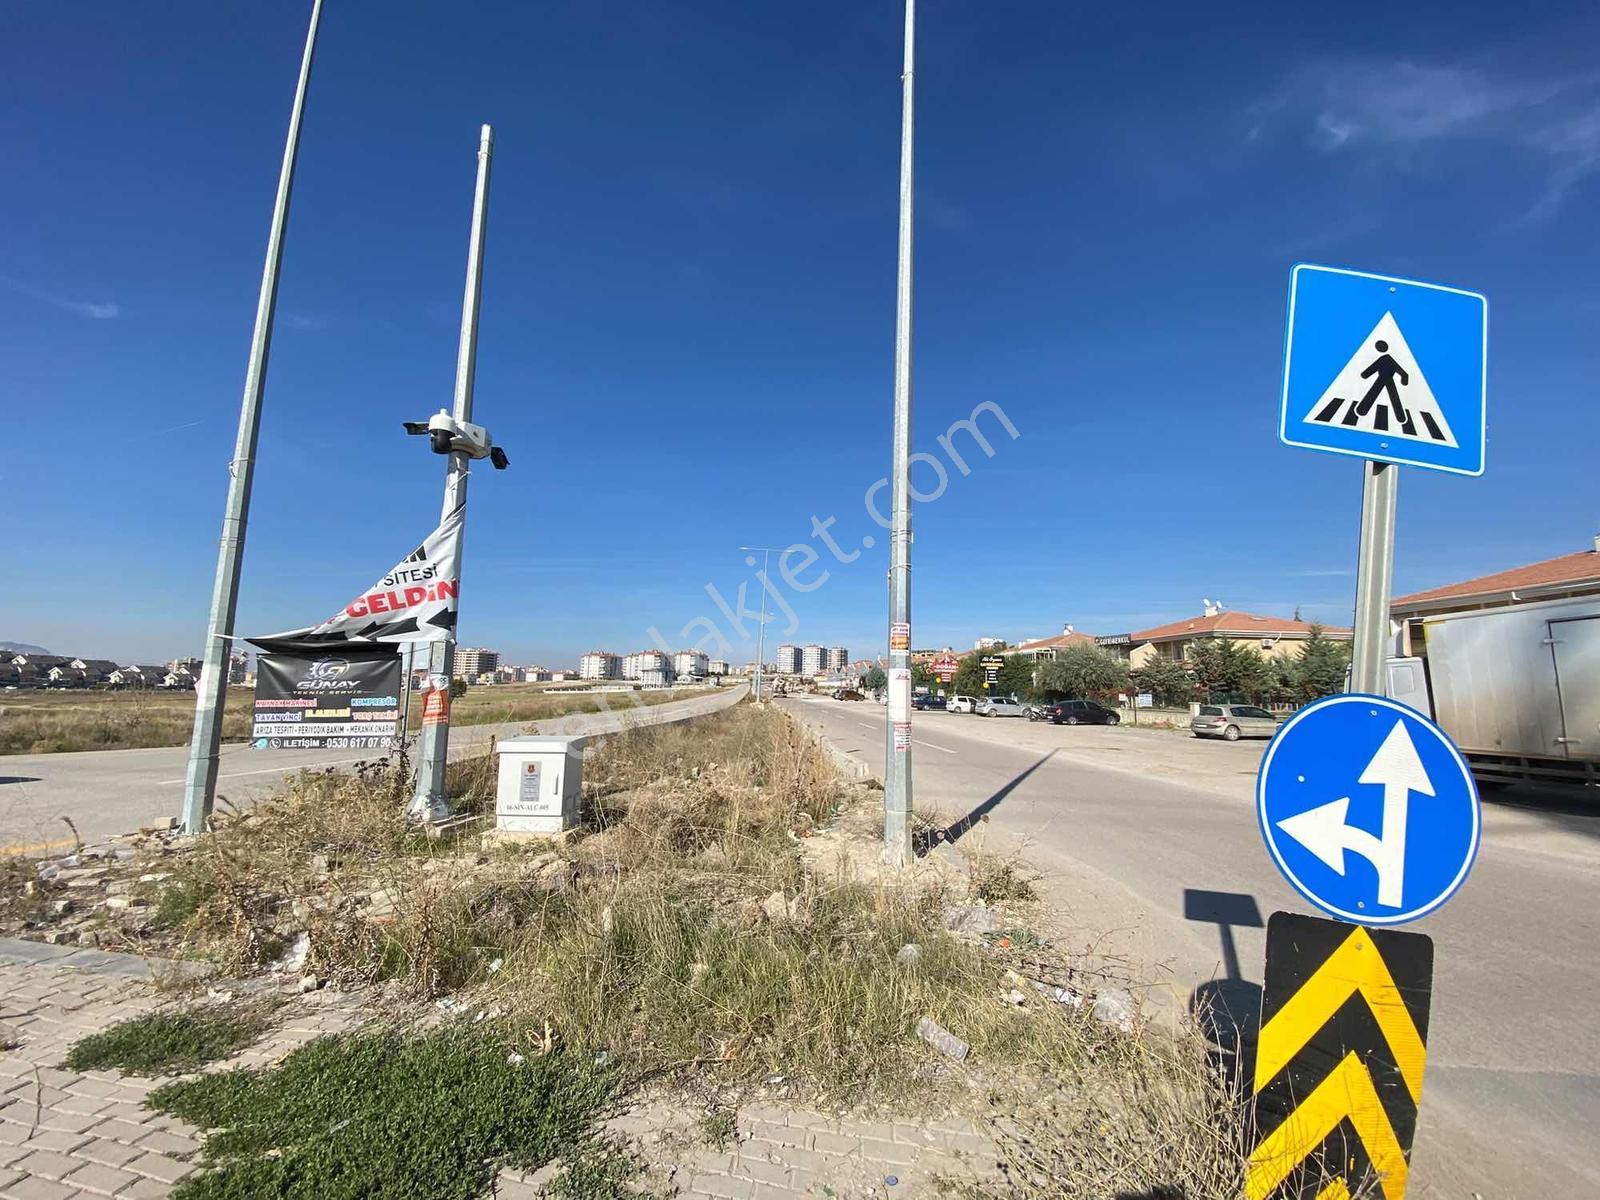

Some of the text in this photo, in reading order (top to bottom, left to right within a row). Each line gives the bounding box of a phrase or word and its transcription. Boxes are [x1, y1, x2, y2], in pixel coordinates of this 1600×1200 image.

[296, 680, 361, 689] GÜNAY
[351, 696, 397, 706] KOMPRESÖR
[255, 713, 281, 722] TAVAN
[350, 737, 367, 748] 617
[368, 737, 379, 747] 07
